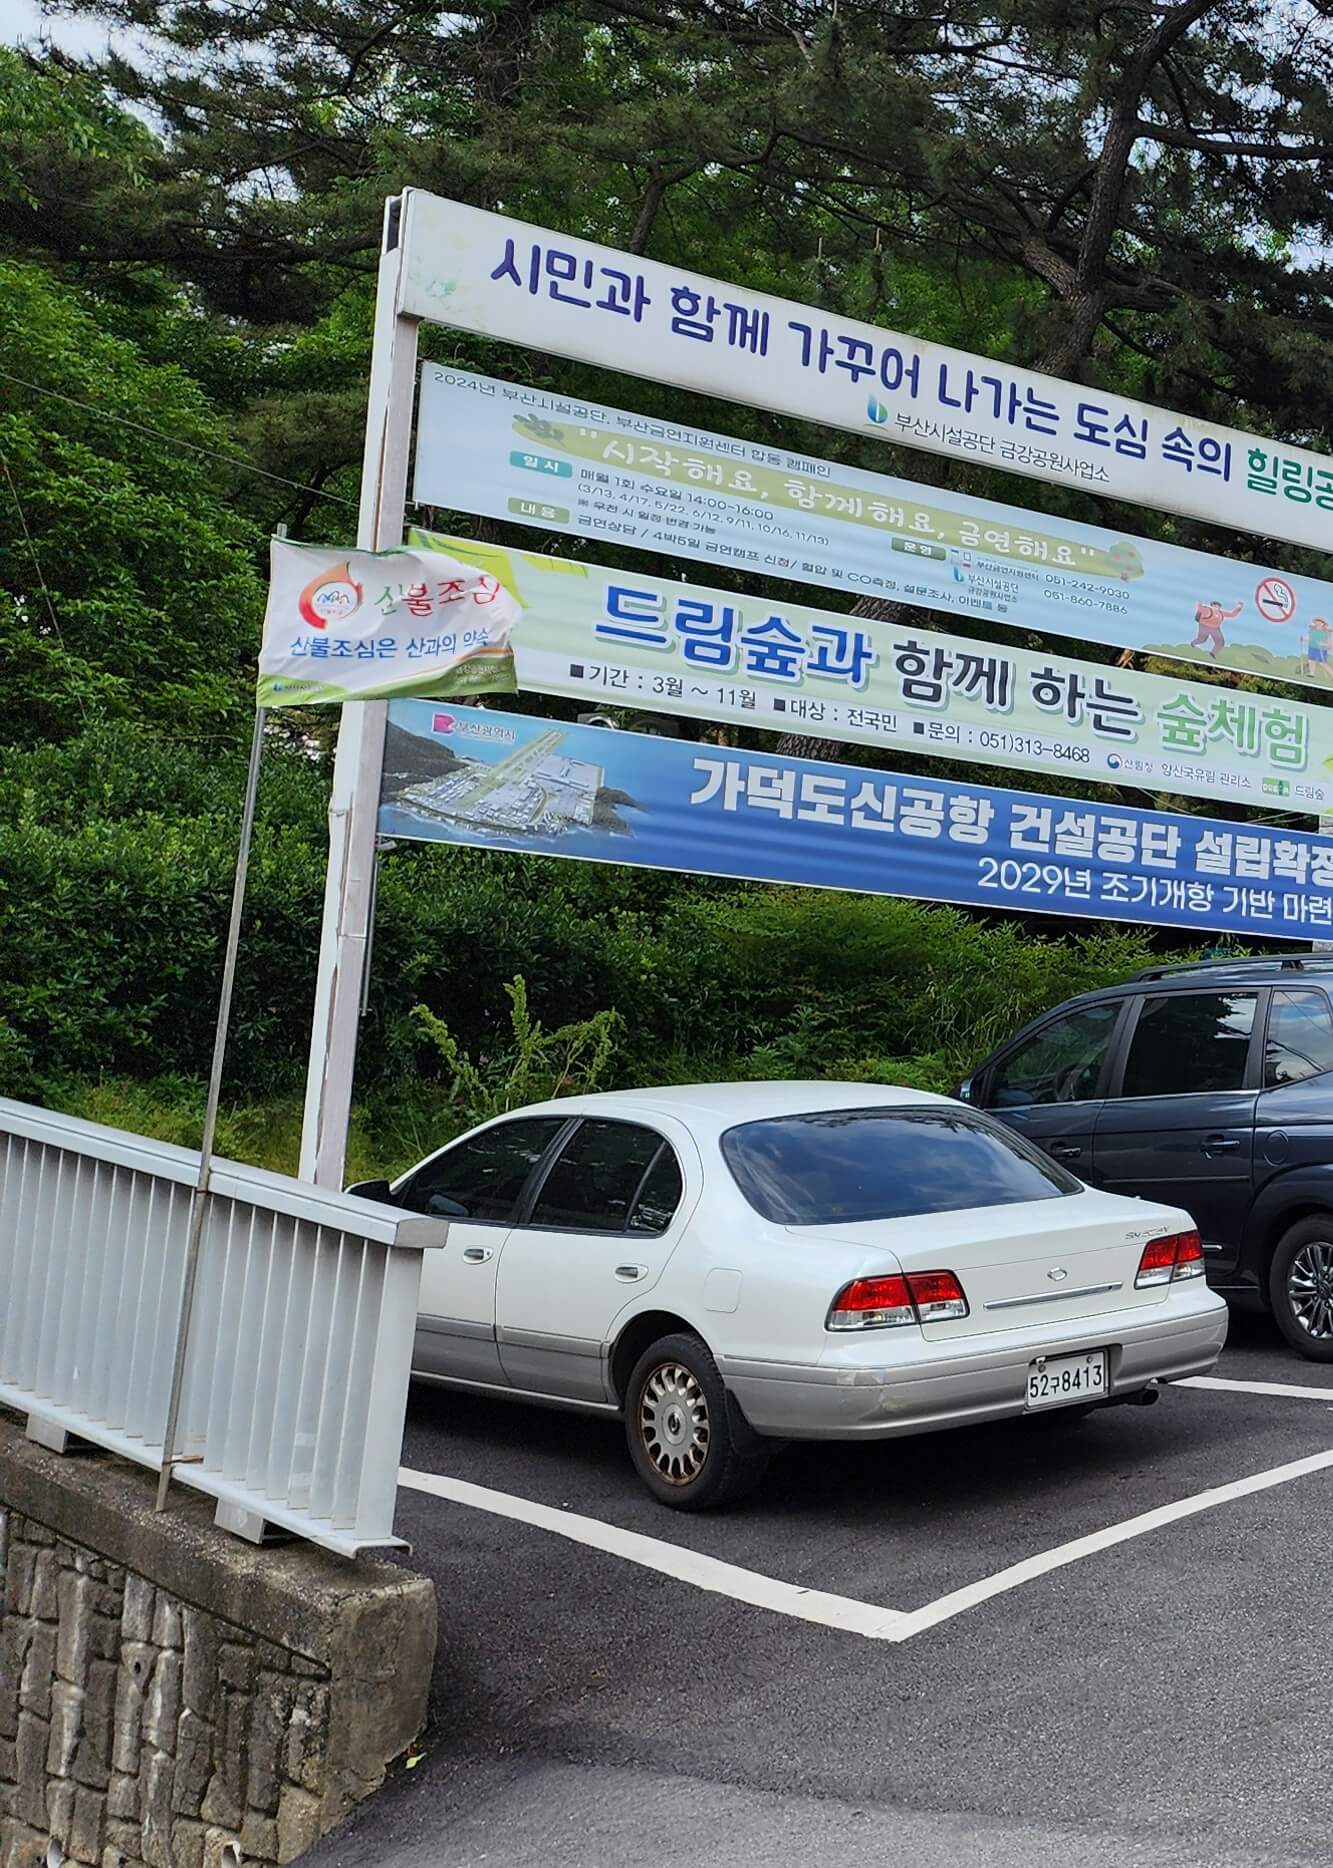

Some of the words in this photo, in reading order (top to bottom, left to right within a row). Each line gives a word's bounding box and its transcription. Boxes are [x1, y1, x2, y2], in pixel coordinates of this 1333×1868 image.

[490, 238, 651, 323] 시민과
[671, 285, 769, 357] 함께
[787, 320, 920, 400] 가꾸어
[937, 363, 1058, 435] 나가는
[1072, 402, 1150, 460] 도심
[1161, 425, 1232, 482] 속의
[434, 371, 495, 397] 2024년
[616, 416, 747, 458] 부산금연지원센터
[751, 448, 781, 467] 합동
[786, 456, 832, 478] 캠페인
[894, 413, 995, 455] 부산시설공단
[999, 440, 1110, 483] 금강공원사업소
[580, 469, 609, 484] 매월
[615, 477, 635, 490] 1회
[640, 484, 682, 500] 수요일
[577, 514, 637, 535] 금연상담
[705, 541, 760, 561] 금연캠프
[373, 576, 501, 617] 산불조심
[1045, 574, 1131, 600] 051-242-9030
[290, 637, 397, 659] 산불조심은
[405, 633, 457, 658] 산과의
[462, 627, 489, 647] 약속
[595, 585, 873, 683] 드림숲과
[893, 640, 1009, 706] 함께
[1031, 666, 1139, 736] 하는
[1157, 694, 1304, 765] 숲체험
[652, 676, 684, 698] 3월
[717, 687, 756, 710] 11월
[847, 707, 898, 733] 전국민
[980, 731, 1090, 764] 051)313-8468
[690, 758, 995, 845] 가덕도신공항
[1009, 803, 1181, 869] 건설공단
[977, 856, 1091, 899] 2029년
[1101, 872, 1214, 912] 조기개항
[1222, 886, 1276, 919] 기반
[1029, 1364, 1102, 1398] 52구8413
